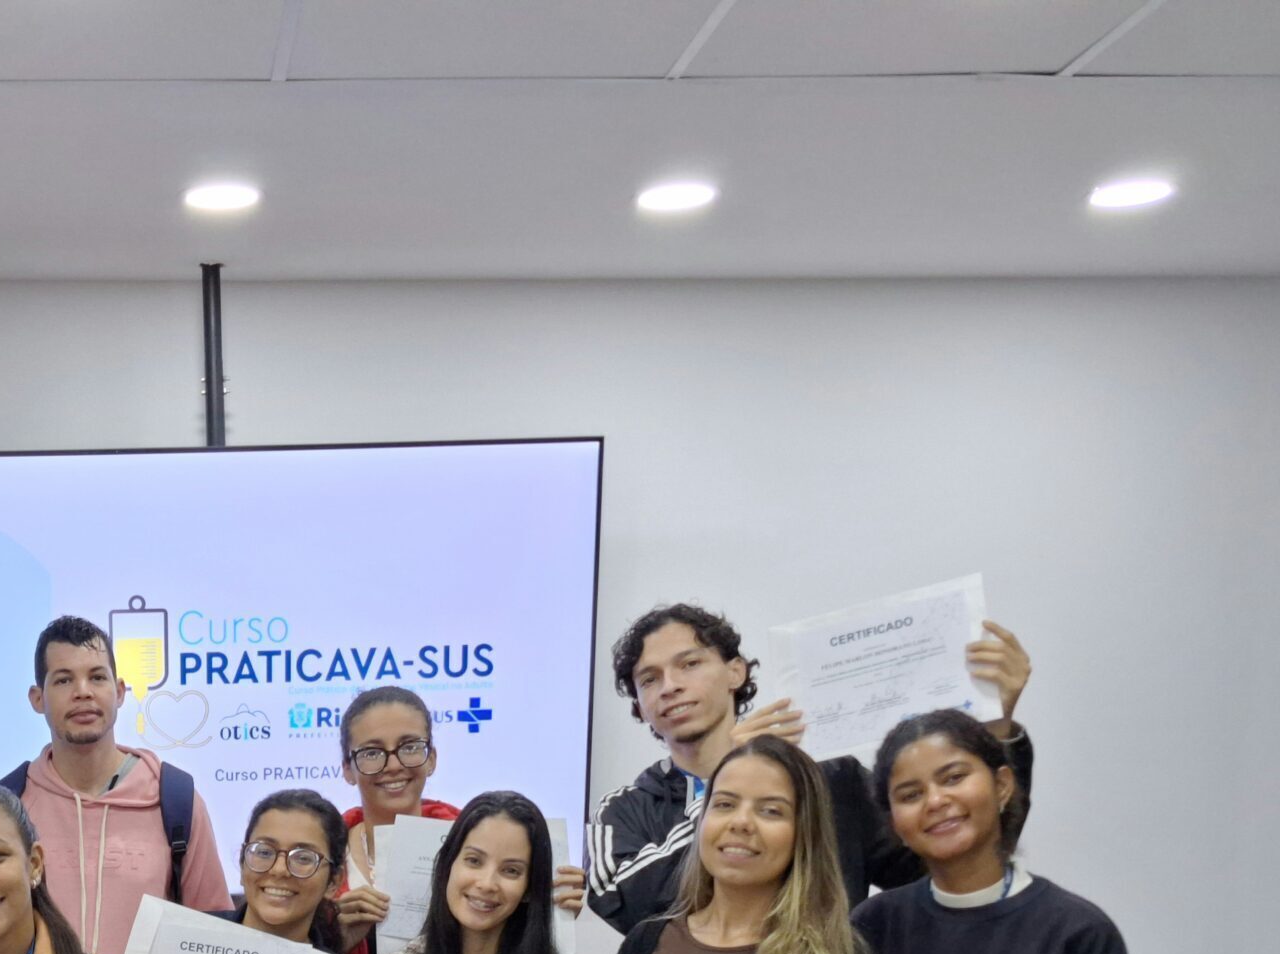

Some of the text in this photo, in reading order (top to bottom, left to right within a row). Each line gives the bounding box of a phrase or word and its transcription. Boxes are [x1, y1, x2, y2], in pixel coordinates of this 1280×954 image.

[178, 610, 289, 646] Curso
[829, 616, 914, 647] CERTIFICADO
[179, 643, 495, 686] PRATICAVA-SUS
[317, 707, 340, 728] Ri
[431, 710, 453, 723] US
[220, 722, 271, 741] otics
[215, 766, 344, 782] Curso PRATICAV
